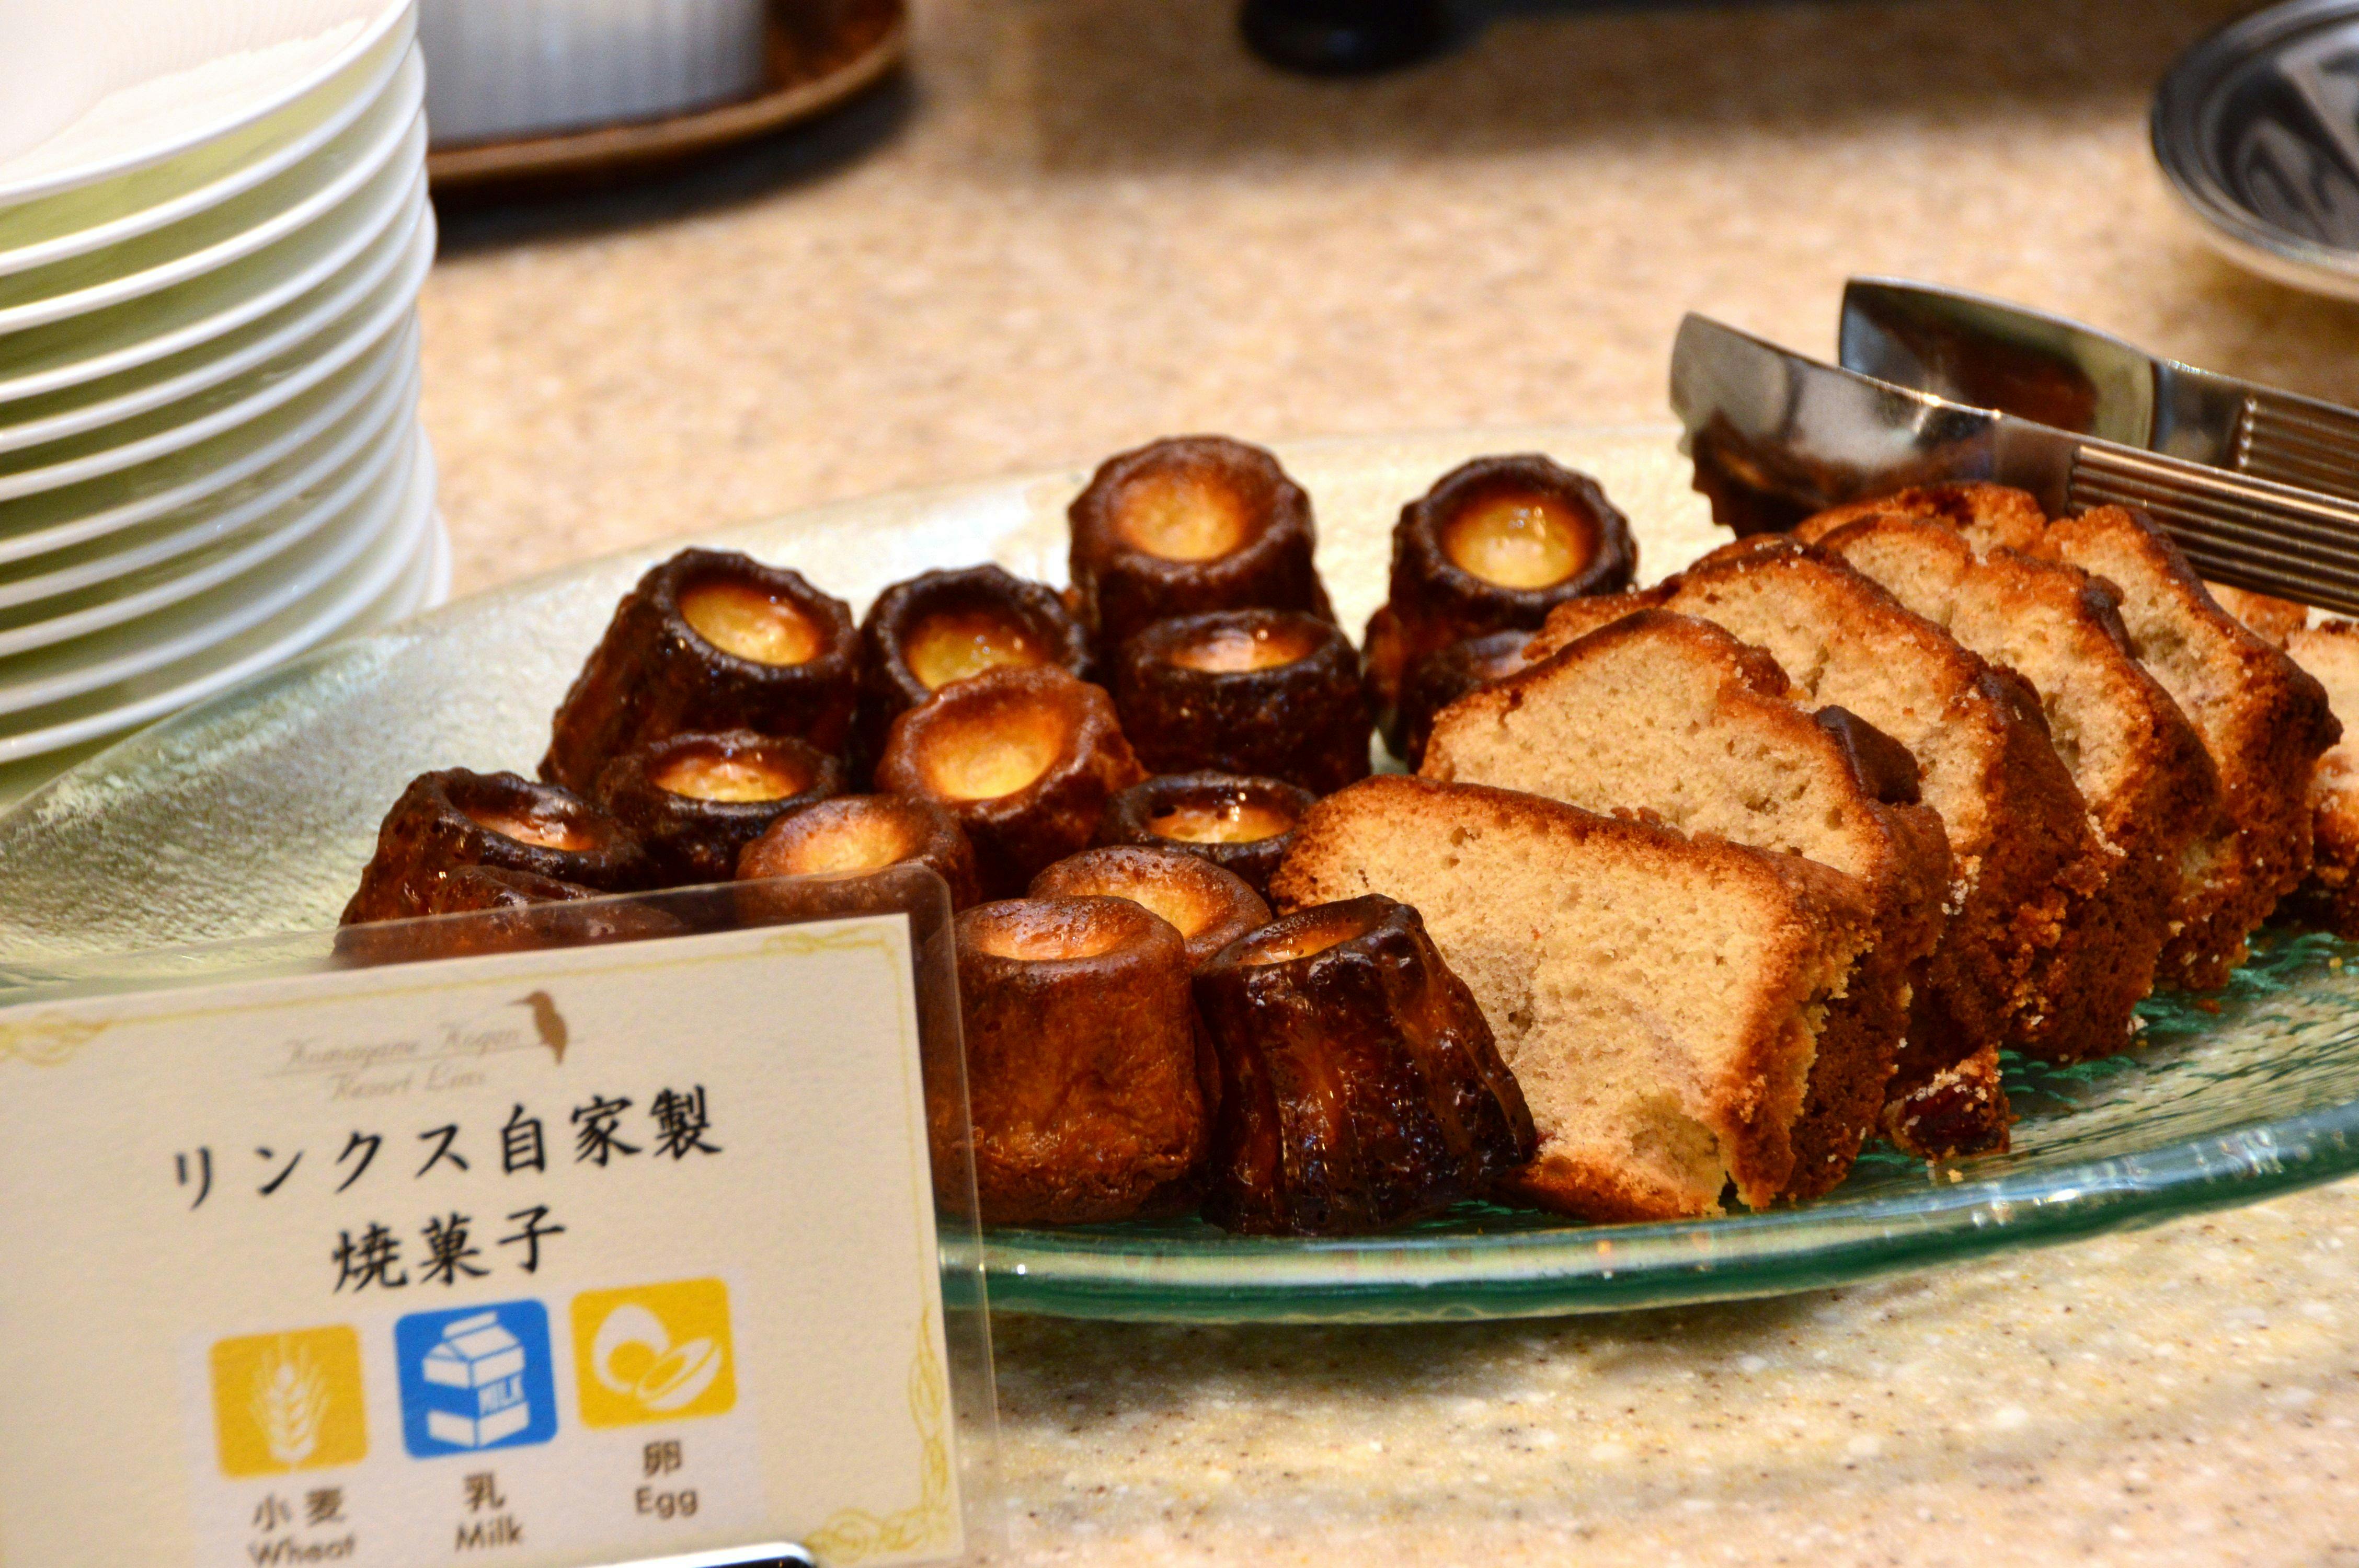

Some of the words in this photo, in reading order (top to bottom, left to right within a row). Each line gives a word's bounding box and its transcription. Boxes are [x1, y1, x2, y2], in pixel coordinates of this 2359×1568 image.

[174, 1083, 723, 1210] リンクス自家製
[332, 1205, 566, 1293] 焼菓子
[644, 1439, 683, 1478] 卵
[252, 1486, 347, 1531] 小麦
[463, 1472, 507, 1512] 乳
[635, 1486, 698, 1520] Egg
[247, 1532, 357, 1567] Wheat
[455, 1515, 522, 1553] Milk
